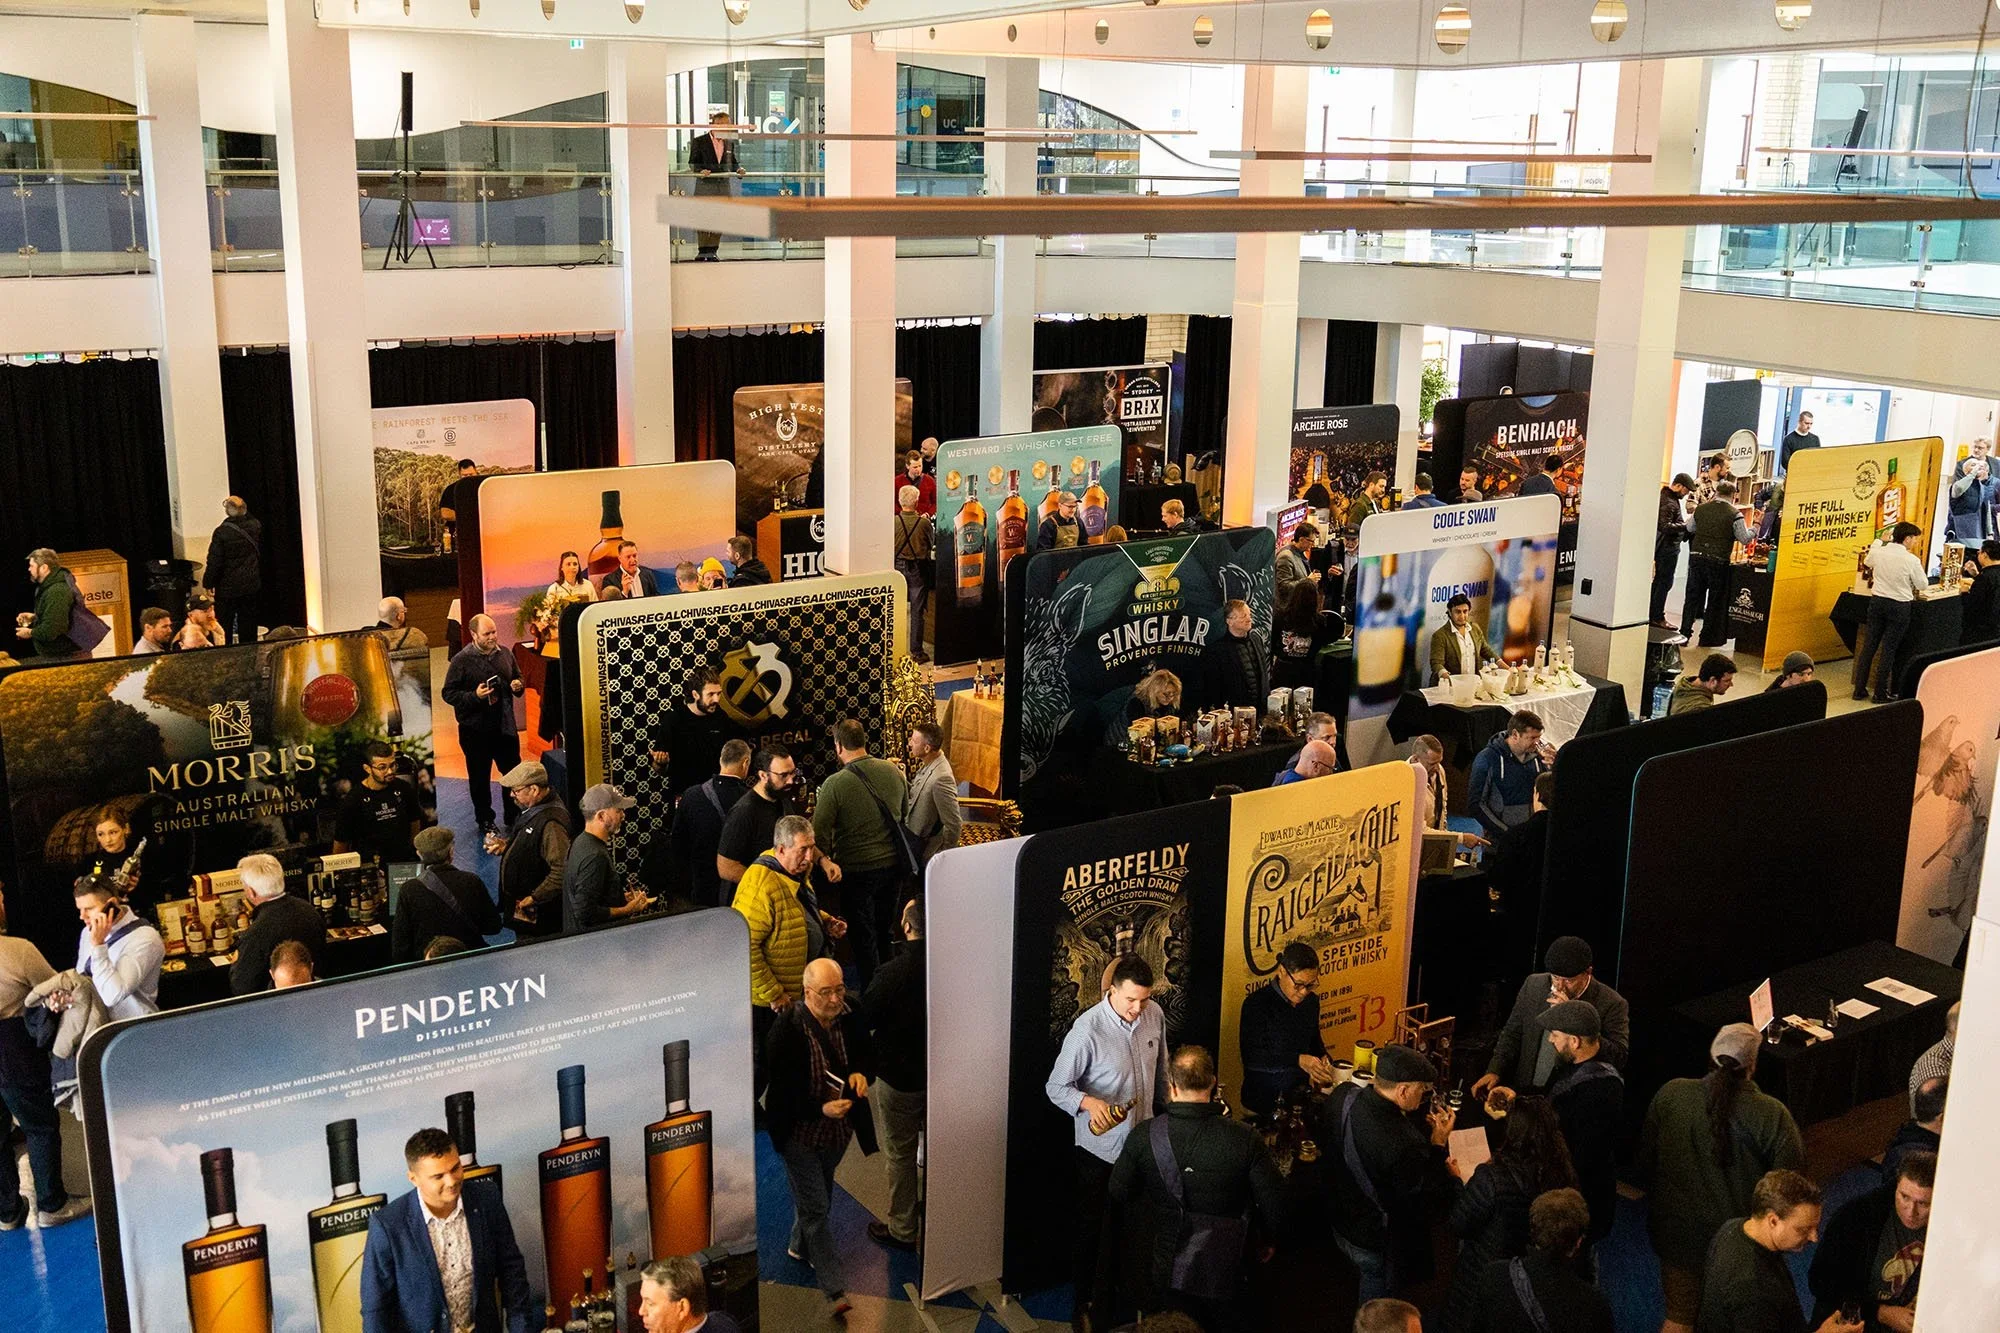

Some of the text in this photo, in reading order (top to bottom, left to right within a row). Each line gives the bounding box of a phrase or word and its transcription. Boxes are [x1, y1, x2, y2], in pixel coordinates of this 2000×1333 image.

[749, 402, 824, 421] HIGH WEST
[1123, 399, 1160, 416] BRIX
[383, 417, 436, 429] RAINFOREST
[441, 415, 468, 425] MEETS
[472, 414, 488, 422] THE
[1293, 418, 1349, 432] ARCHIE ROSE
[1497, 418, 1577, 445] BENRIACH
[757, 441, 817, 451] DISTILLERY
[947, 445, 1000, 458] WESTWARD
[1003, 444, 1013, 453] IS
[1016, 438, 1063, 451] WHISKEY
[1064, 436, 1083, 446] SET
[1086, 433, 1113, 443] FREE
[1515, 449, 1531, 457] SINGLE
[1531, 448, 1542, 456] MALT
[1728, 446, 1753, 457] JURA
[1433, 506, 1497, 530] COOLE SWAN
[1798, 499, 1845, 516] THE FULL
[1795, 510, 1872, 530] IRISH WHISKEY
[1454, 532, 1480, 541] CHOCOLATE
[1793, 526, 1858, 544] EXPERIENCE
[1432, 580, 1489, 603] COOLE SWAN
[1132, 599, 1179, 615] WHISKY
[1097, 615, 1210, 661] SINGLAR
[1105, 644, 1202, 671] PROVENCE FINISH
[147, 744, 316, 793] MORRIS
[176, 785, 296, 814] AUSTRALIAN
[154, 797, 318, 833] SINGLE MALT WHISKY
[1260, 826, 1294, 850] EDWARD
[325, 858, 353, 867] MORRIS
[1063, 843, 1190, 891] ABERFELDY
[1069, 877, 1180, 915] THE GOLDEN DRAM
[1243, 801, 1400, 976] CRAIGELLACHIE
[1074, 890, 1175, 925] SINGLE MALT SCOTCH WHISKY
[1322, 935, 1383, 962] SPEYSIDE
[1352, 947, 1389, 967] WHISKY
[1330, 989, 1338, 997] IN
[355, 974, 546, 1039] PENDERYN
[1358, 996, 1386, 1034] 13
[416, 1018, 492, 1042] DISTILLERY
[179, 1103, 190, 1113] AT
[192, 1098, 210, 1109] THE
[211, 1092, 239, 1105] DAWN
[240, 1090, 252, 1099] OF
[253, 1086, 270, 1096] THE
[271, 1081, 292, 1091] NEW
[355, 1060, 385, 1073] GROUP
[386, 1058, 396, 1066] OF
[398, 1050, 431, 1064] FRIENDS
[432, 1045, 455, 1056] FROM
[456, 1040, 474, 1050] THIS
[475, 1031, 515, 1047] BEAUTIFUL
[516, 1027, 534, 1037] PART
[547, 1020, 561, 1030] THE
[562, 1013, 590, 1026] WORLD
[591, 1011, 603, 1019] SET
[603, 1007, 620, 1017] OUT
[620, 1003, 641, 1013] WITH
[648, 995, 672, 1007] SIMPLE
[197, 1114, 209, 1122] AS
[211, 1110, 227, 1120] THE
[228, 1104, 252, 1116] FIRST
[252, 1097, 281, 1110] WELSH
[283, 1087, 327, 1103] DISTILLERS
[328, 1085, 339, 1093] IN
[340, 1079, 363, 1090] MORE
[365, 1074, 389, 1085] THAN
[436, 1058, 456, 1069] THEY
[457, 1054, 477, 1064] WERE
[478, 1043, 527, 1059] DETERMINED
[541, 1029, 581, 1045] RESURRECT
[588, 1023, 606, 1033] LOST
[606, 1020, 620, 1029] ART
[621, 1016, 638, 1026] AND
[639, 1014, 648, 1022] BY
[648, 1009, 674, 1020] DOING
[345, 1087, 374, 1099] CREATE
[382, 1078, 413, 1089] WHISKY
[415, 1073, 424, 1081] AS
[425, 1070, 445, 1080] PURE
[446, 1066, 464, 1075] AND
[465, 1058, 501, 1072] PRECIOUS
[502, 1055, 512, 1063] AS
[513, 1048, 538, 1060] WELSH
[652, 1121, 704, 1142] PENDERYN
[546, 1147, 601, 1170] PENDERYN
[193, 1236, 258, 1262] PENDERYN
